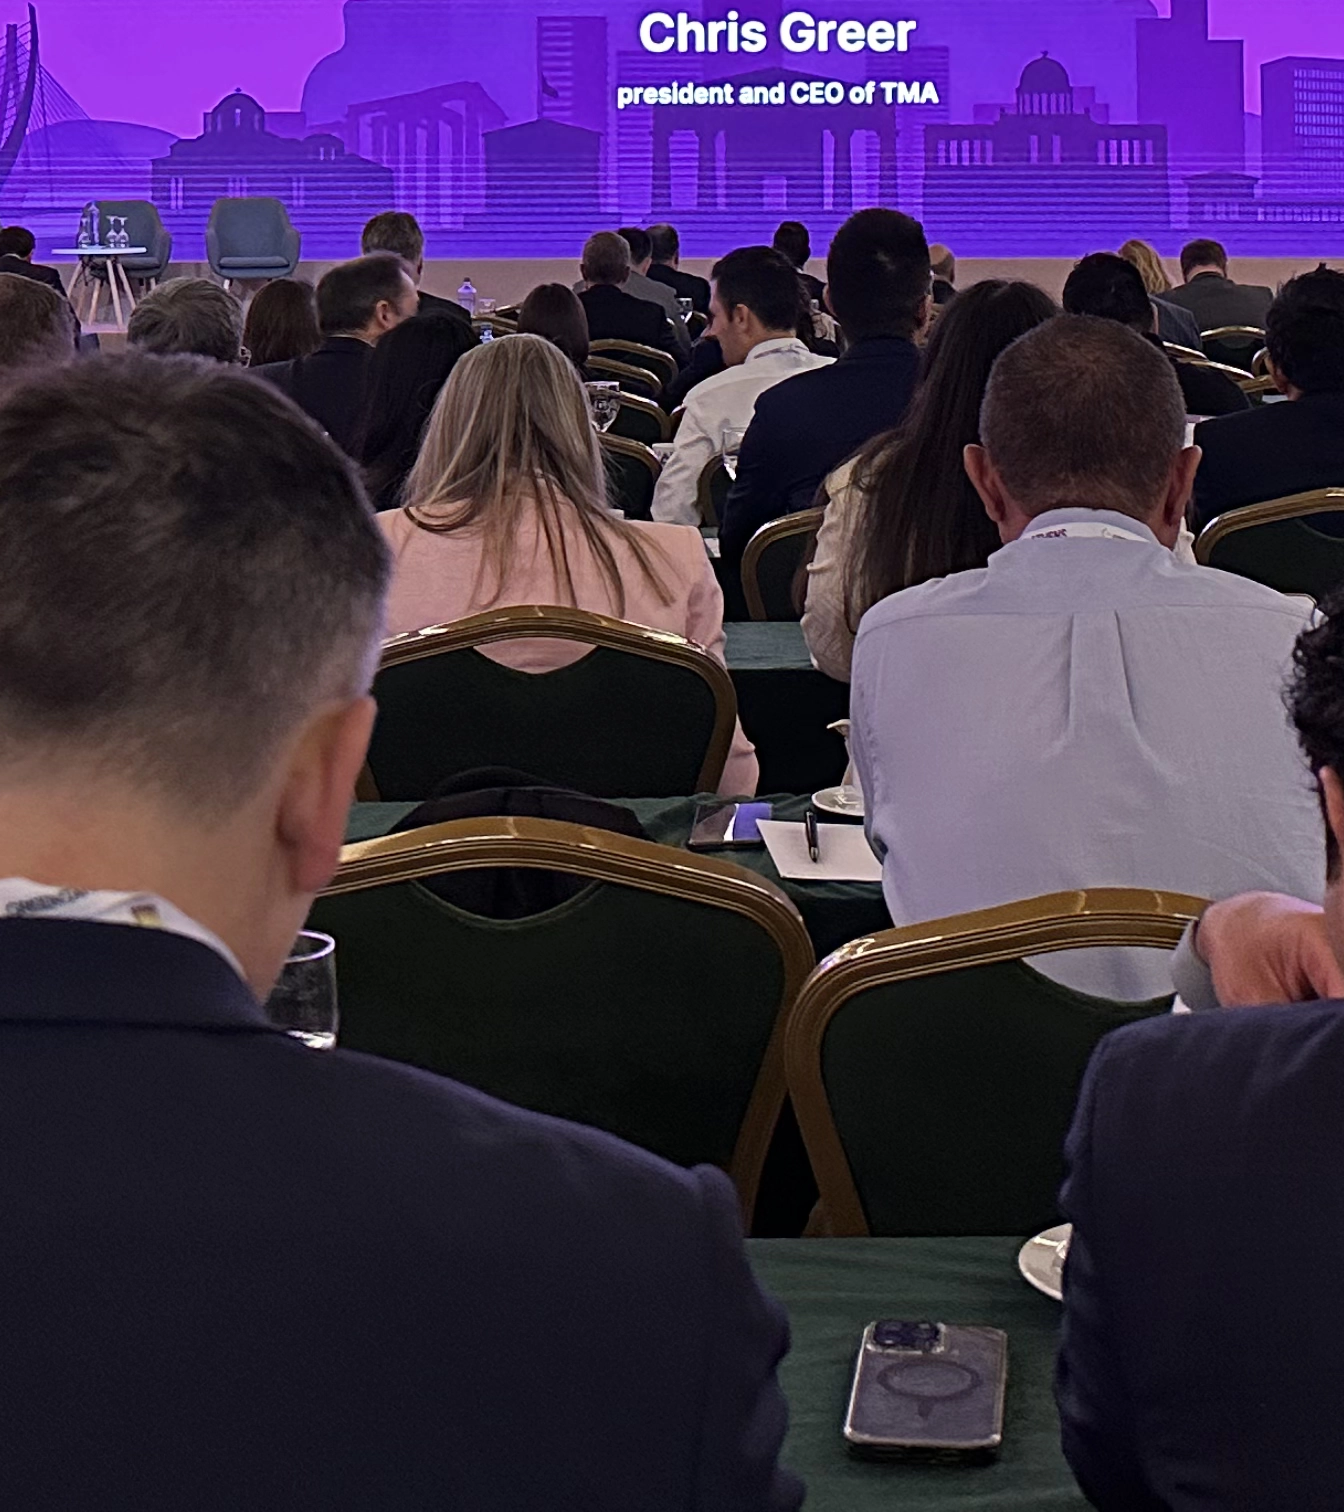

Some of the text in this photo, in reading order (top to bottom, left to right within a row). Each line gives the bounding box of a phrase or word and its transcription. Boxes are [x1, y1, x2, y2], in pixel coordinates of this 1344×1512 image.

[639, 10, 917, 53] Chris Greer
[617, 80, 940, 110] president and CEO of TMA
